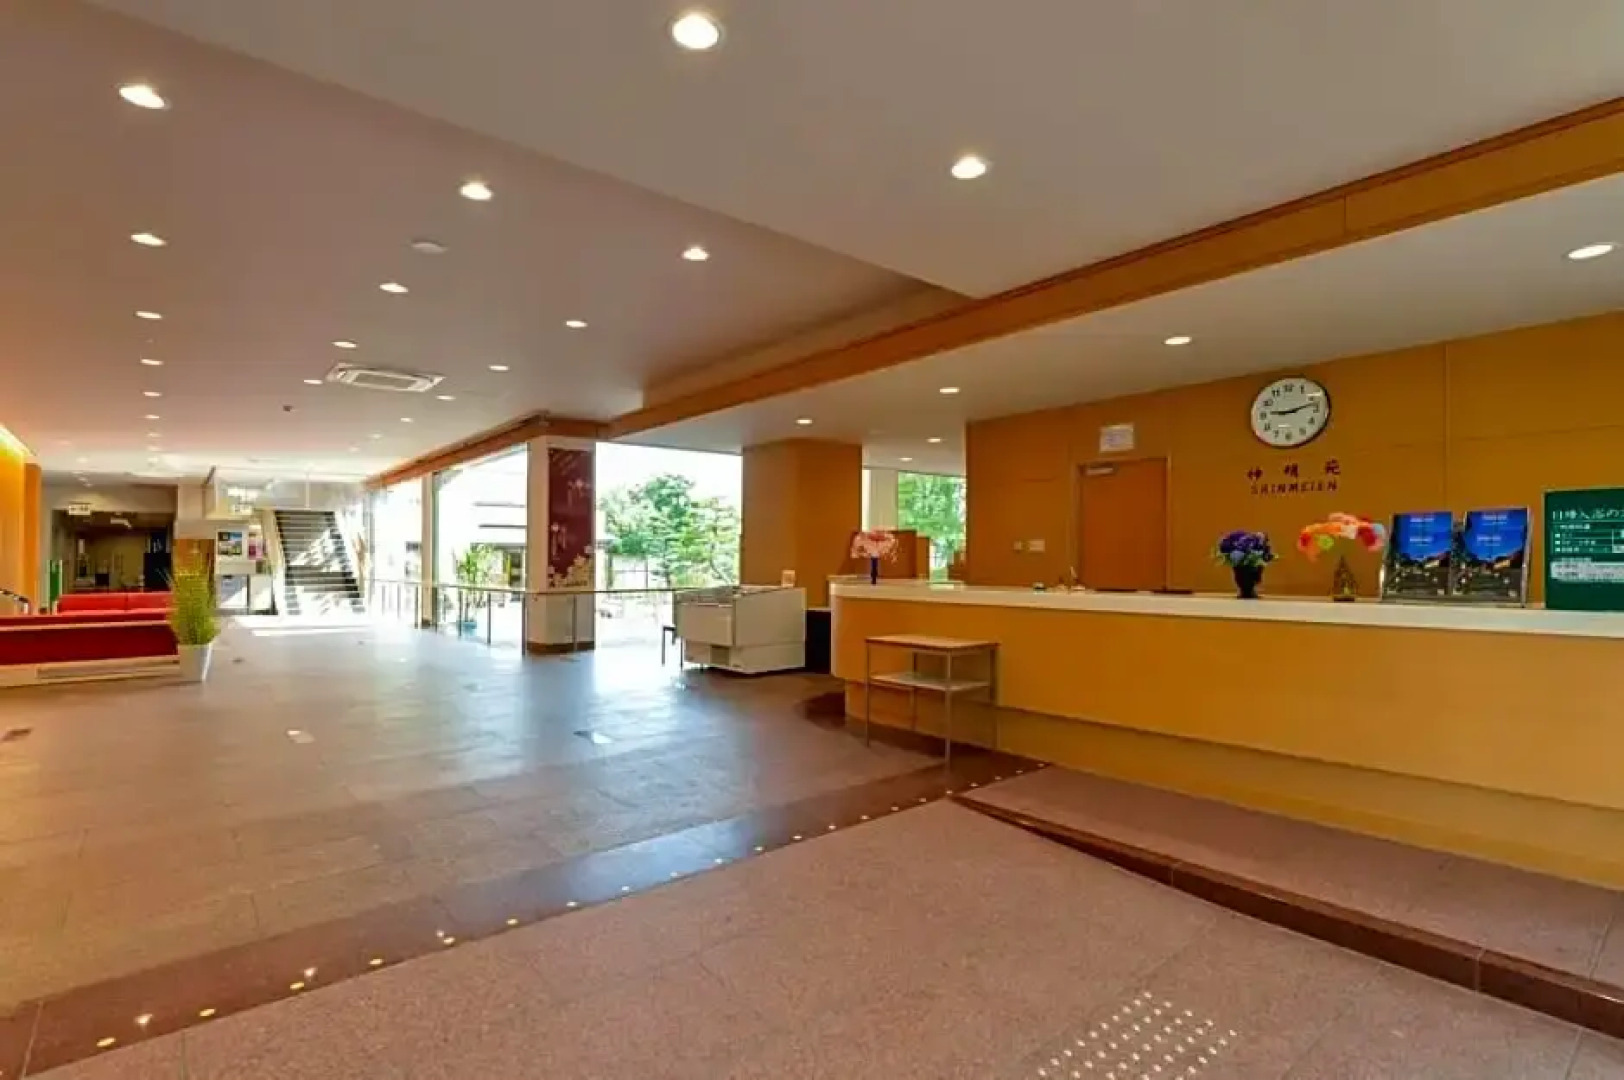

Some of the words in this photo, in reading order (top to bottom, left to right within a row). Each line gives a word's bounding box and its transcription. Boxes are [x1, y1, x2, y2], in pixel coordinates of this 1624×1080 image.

[1283, 384, 1294, 393] 12
[1271, 389, 1280, 398] 11
[1263, 399, 1273, 407] 10
[1250, 480, 1338, 495] SHINMEIEN
